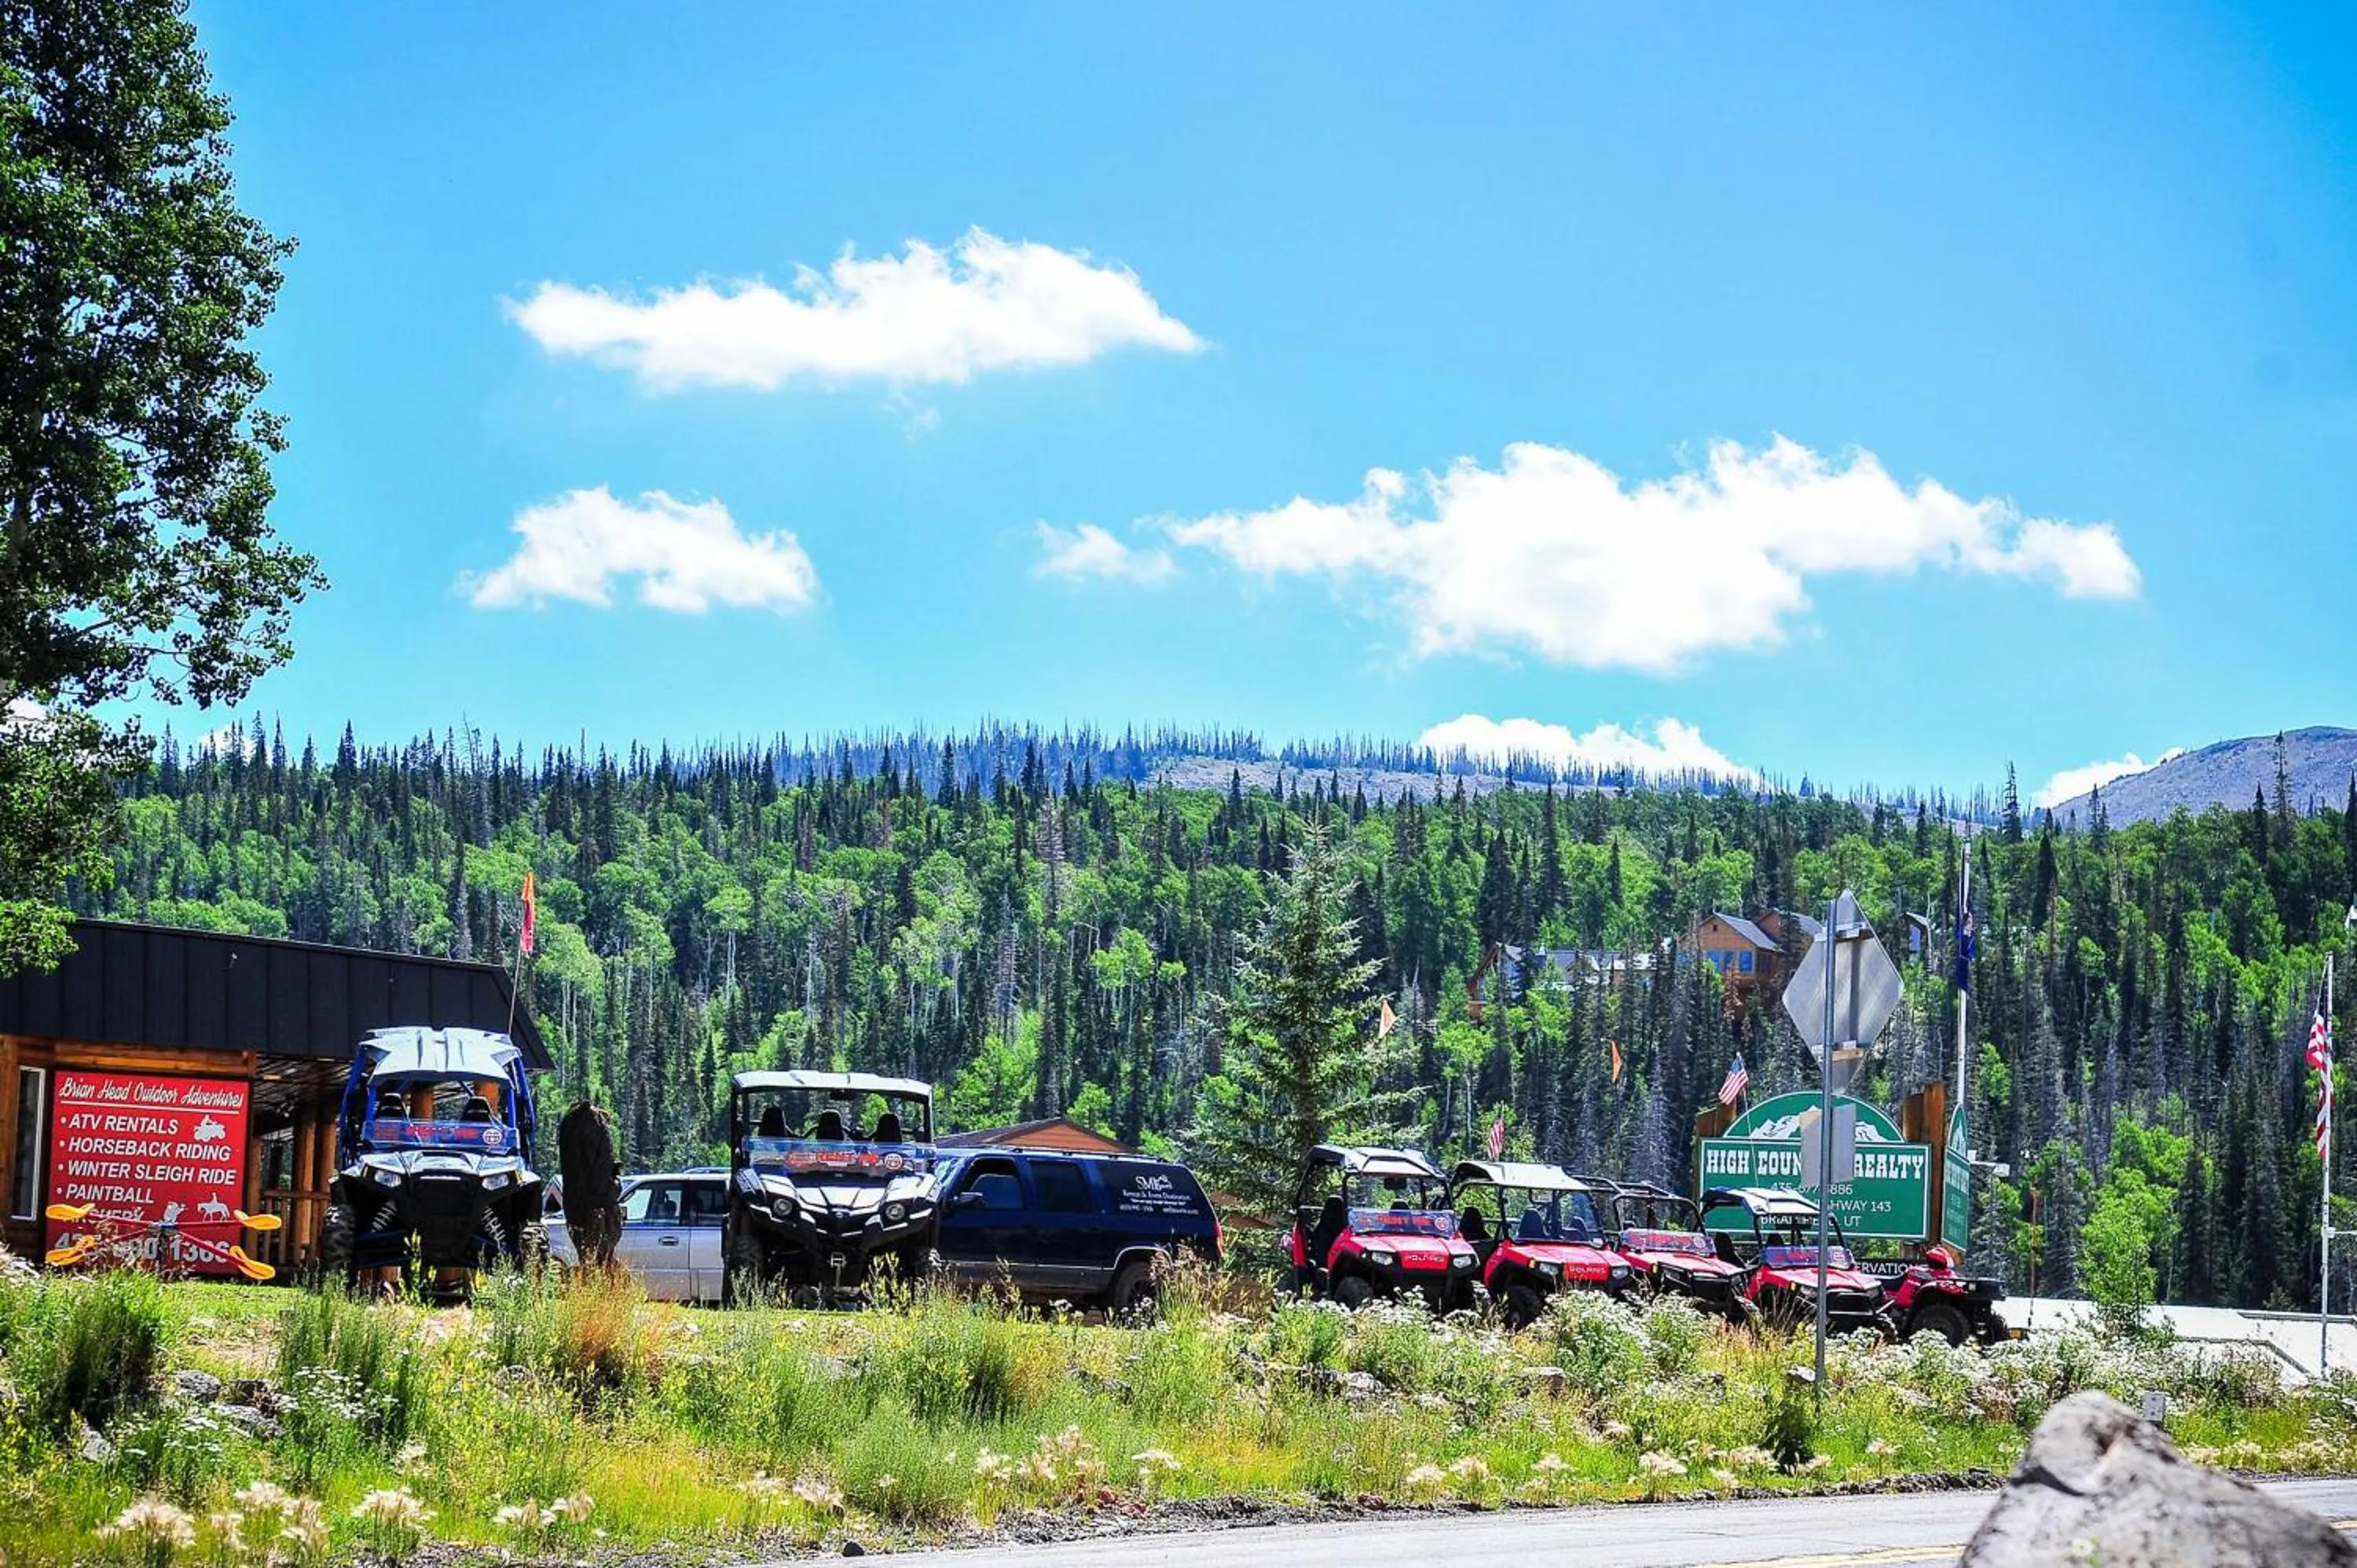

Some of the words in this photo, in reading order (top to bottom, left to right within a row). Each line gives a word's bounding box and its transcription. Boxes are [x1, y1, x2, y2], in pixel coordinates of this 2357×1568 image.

[59, 1077, 94, 1098] Brian
[97, 1079, 132, 1101] Head
[134, 1082, 178, 1104] Outdoor
[181, 1085, 244, 1108] Adventures
[69, 1114, 101, 1130] ATV
[104, 1115, 179, 1134] RENTALS
[69, 1138, 172, 1157] HORSEBACK
[175, 1143, 231, 1161] RIDING
[68, 1160, 130, 1179] WINTER
[134, 1163, 195, 1182] SLEIGH
[197, 1167, 236, 1185] RIDE
[1706, 1150, 1750, 1174] HIGH
[66, 1184, 154, 1204] PAINTBALL
[1871, 1201, 1891, 1212] 143
[1844, 1216, 1862, 1227] UT
